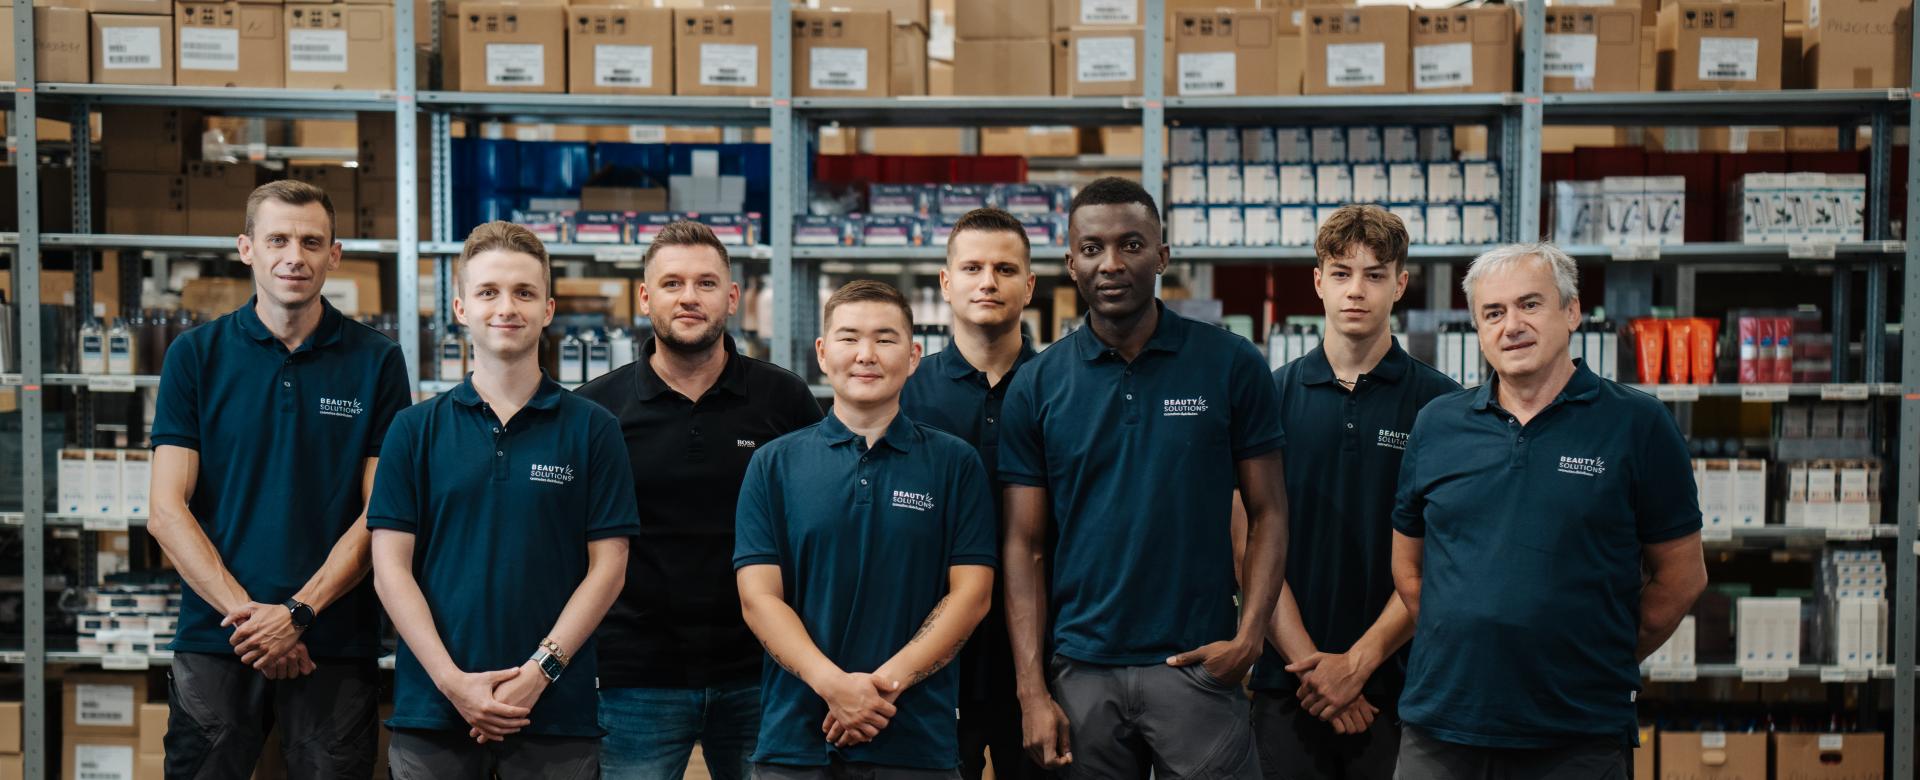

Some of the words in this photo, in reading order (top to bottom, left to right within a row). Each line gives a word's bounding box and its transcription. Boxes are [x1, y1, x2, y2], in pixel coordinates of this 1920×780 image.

[320, 397, 353, 407] BEAUTY
[1378, 429, 1410, 440] BEAUTY
[1378, 435, 1409, 447] SOLUTIO
[1560, 456, 1595, 466] BEAUTY
[531, 463, 565, 474] BEAUTY
[893, 490, 925, 500] BEAUTY
